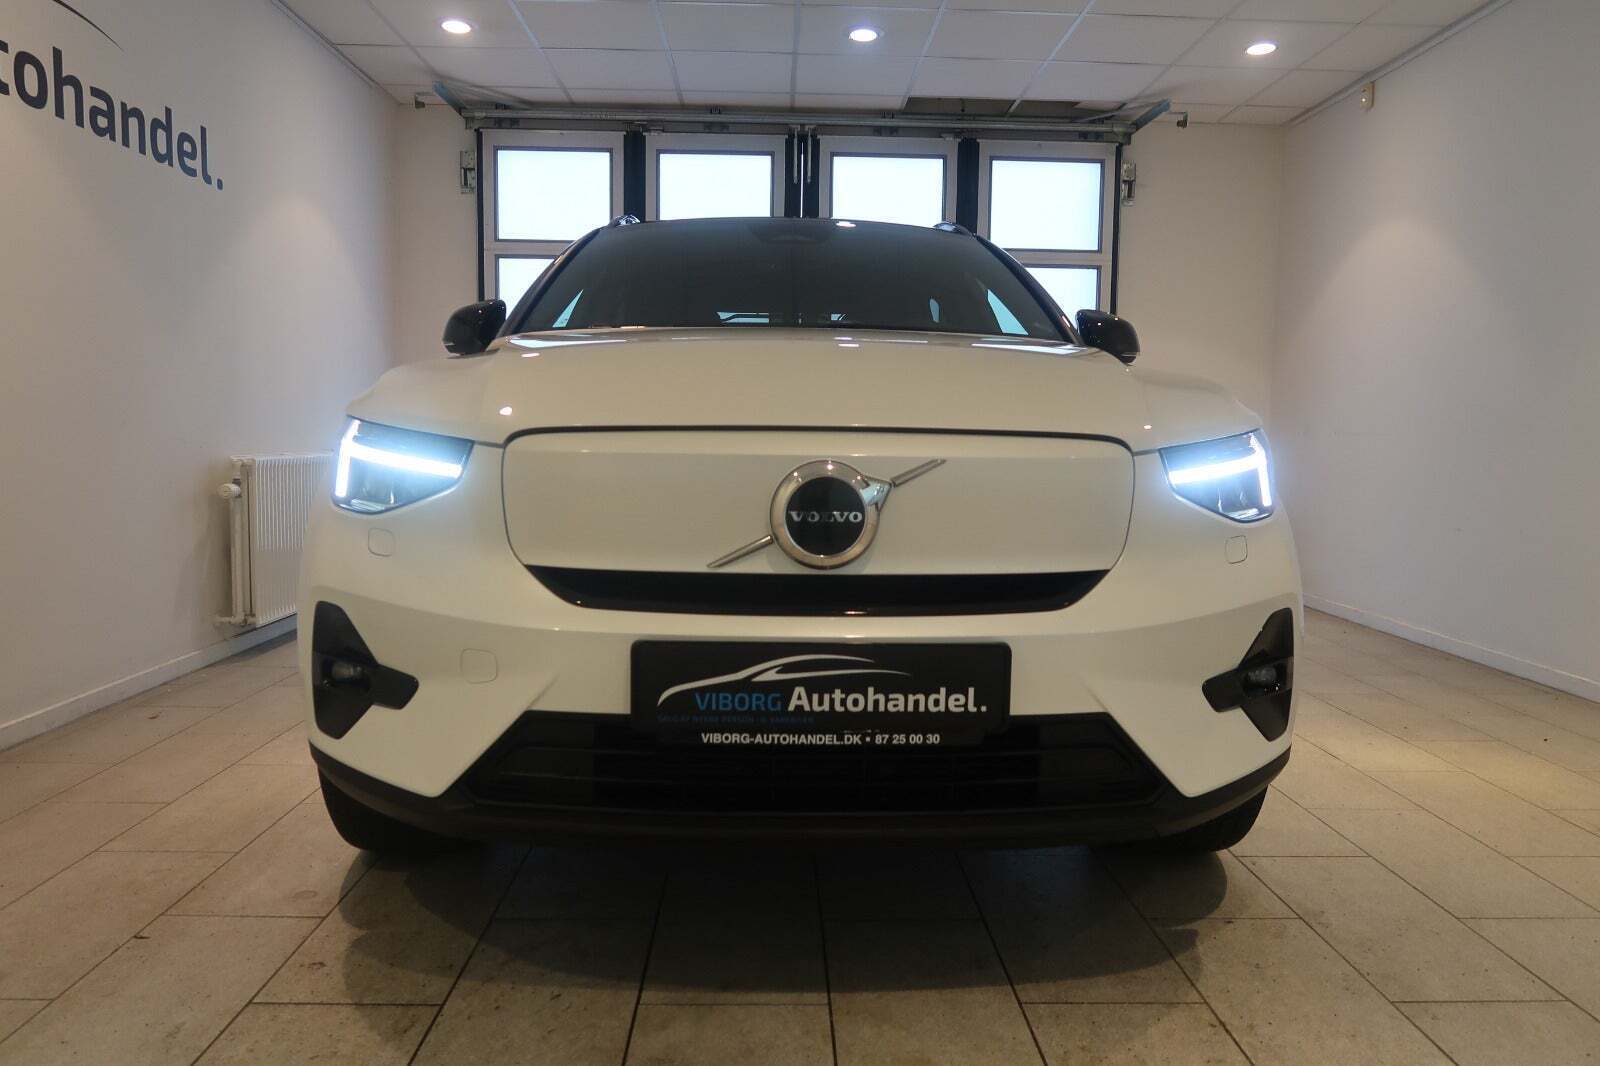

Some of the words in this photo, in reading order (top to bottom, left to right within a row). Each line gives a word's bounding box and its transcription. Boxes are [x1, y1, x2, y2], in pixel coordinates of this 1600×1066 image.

[789, 510, 863, 523] VOLVO
[695, 692, 782, 712] VIBORG
[787, 686, 987, 713] Autohandel.
[701, 732, 862, 745] VIBORG-AUTOHANDEL.DK
[875, 734, 889, 745] 87
[892, 734, 906, 745] 25
[909, 734, 923, 745] 00
[926, 734, 940, 745] 30
